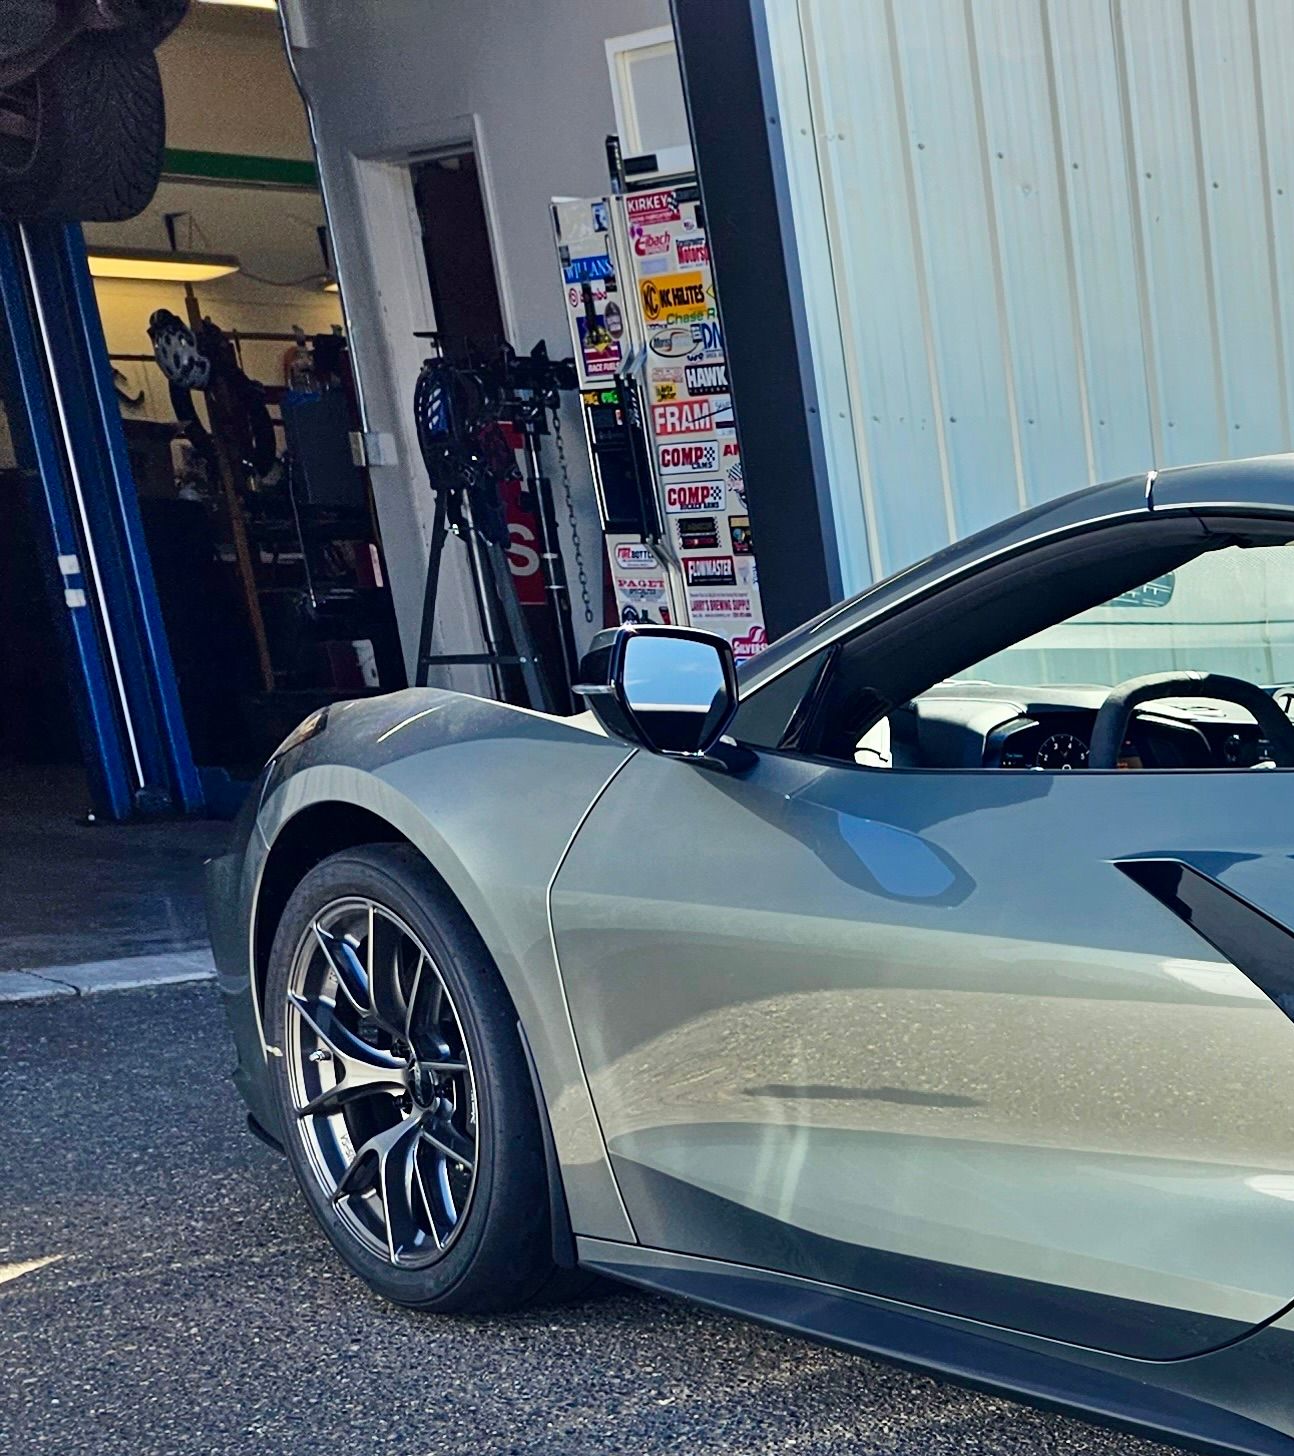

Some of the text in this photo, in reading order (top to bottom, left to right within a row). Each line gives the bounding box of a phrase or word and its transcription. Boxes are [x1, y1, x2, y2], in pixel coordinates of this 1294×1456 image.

[627, 194, 668, 213] KIRKEY
[580, 288, 608, 302] bmbo
[659, 290, 673, 309] KC
[666, 310, 704, 325] Chase
[686, 365, 728, 389] HAWK
[653, 402, 711, 434] FRAM
[661, 446, 704, 468] COMP
[668, 485, 710, 507] COMP
[687, 559, 732, 584] FLOWMASTER
